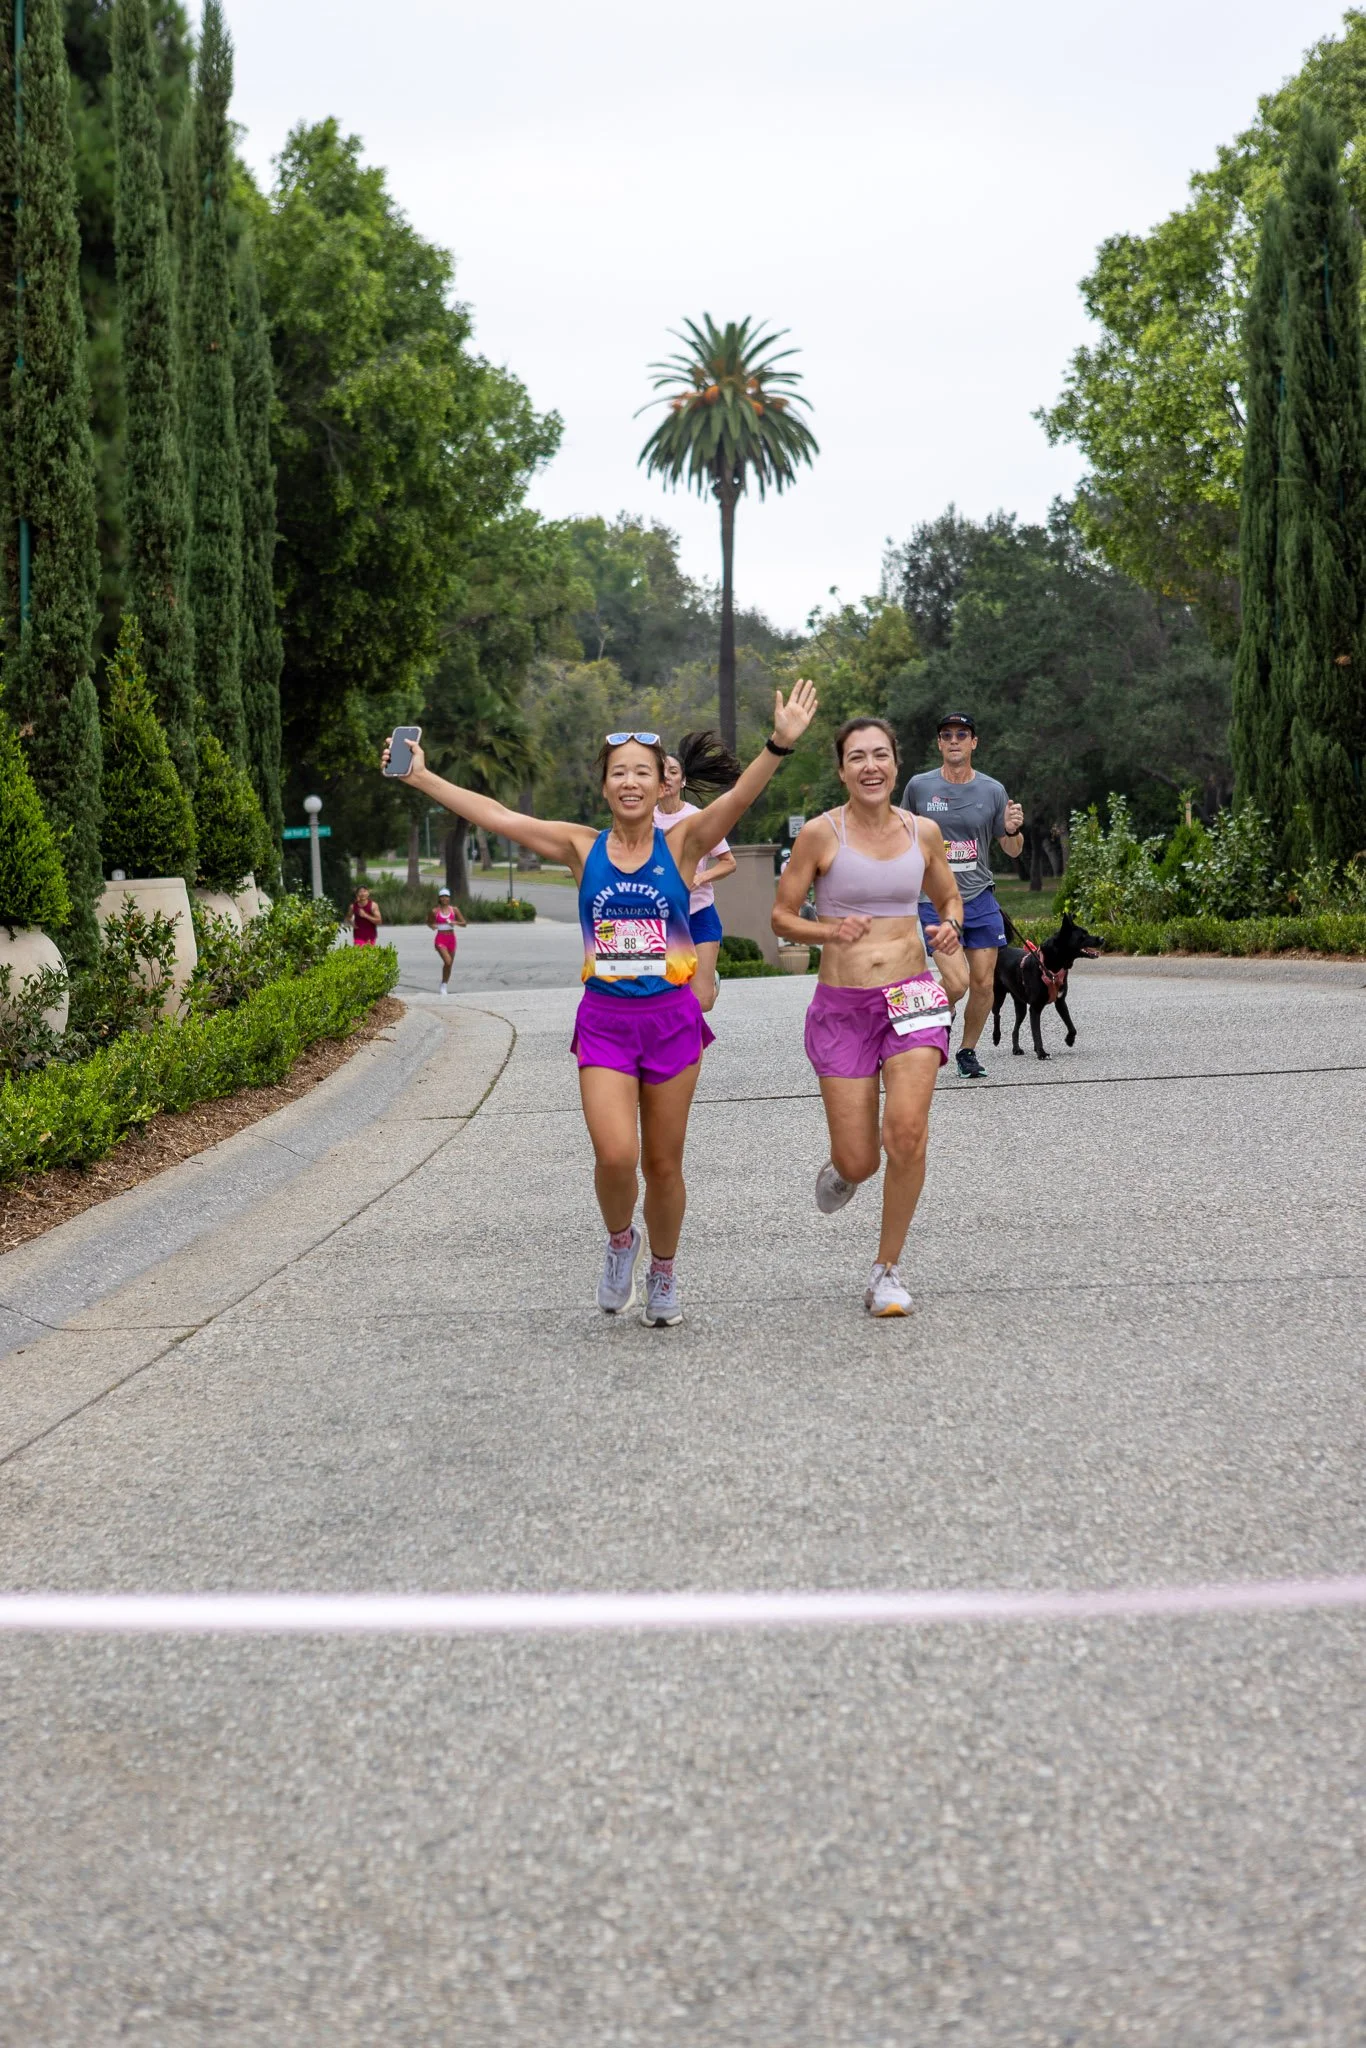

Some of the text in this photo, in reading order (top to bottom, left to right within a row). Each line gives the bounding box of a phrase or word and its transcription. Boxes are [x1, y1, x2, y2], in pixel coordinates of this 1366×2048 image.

[592, 882, 670, 918] RUN WITH US
[605, 907, 657, 916] PASADENA
[624, 937, 636, 949] 88
[913, 996, 925, 1008] 81
